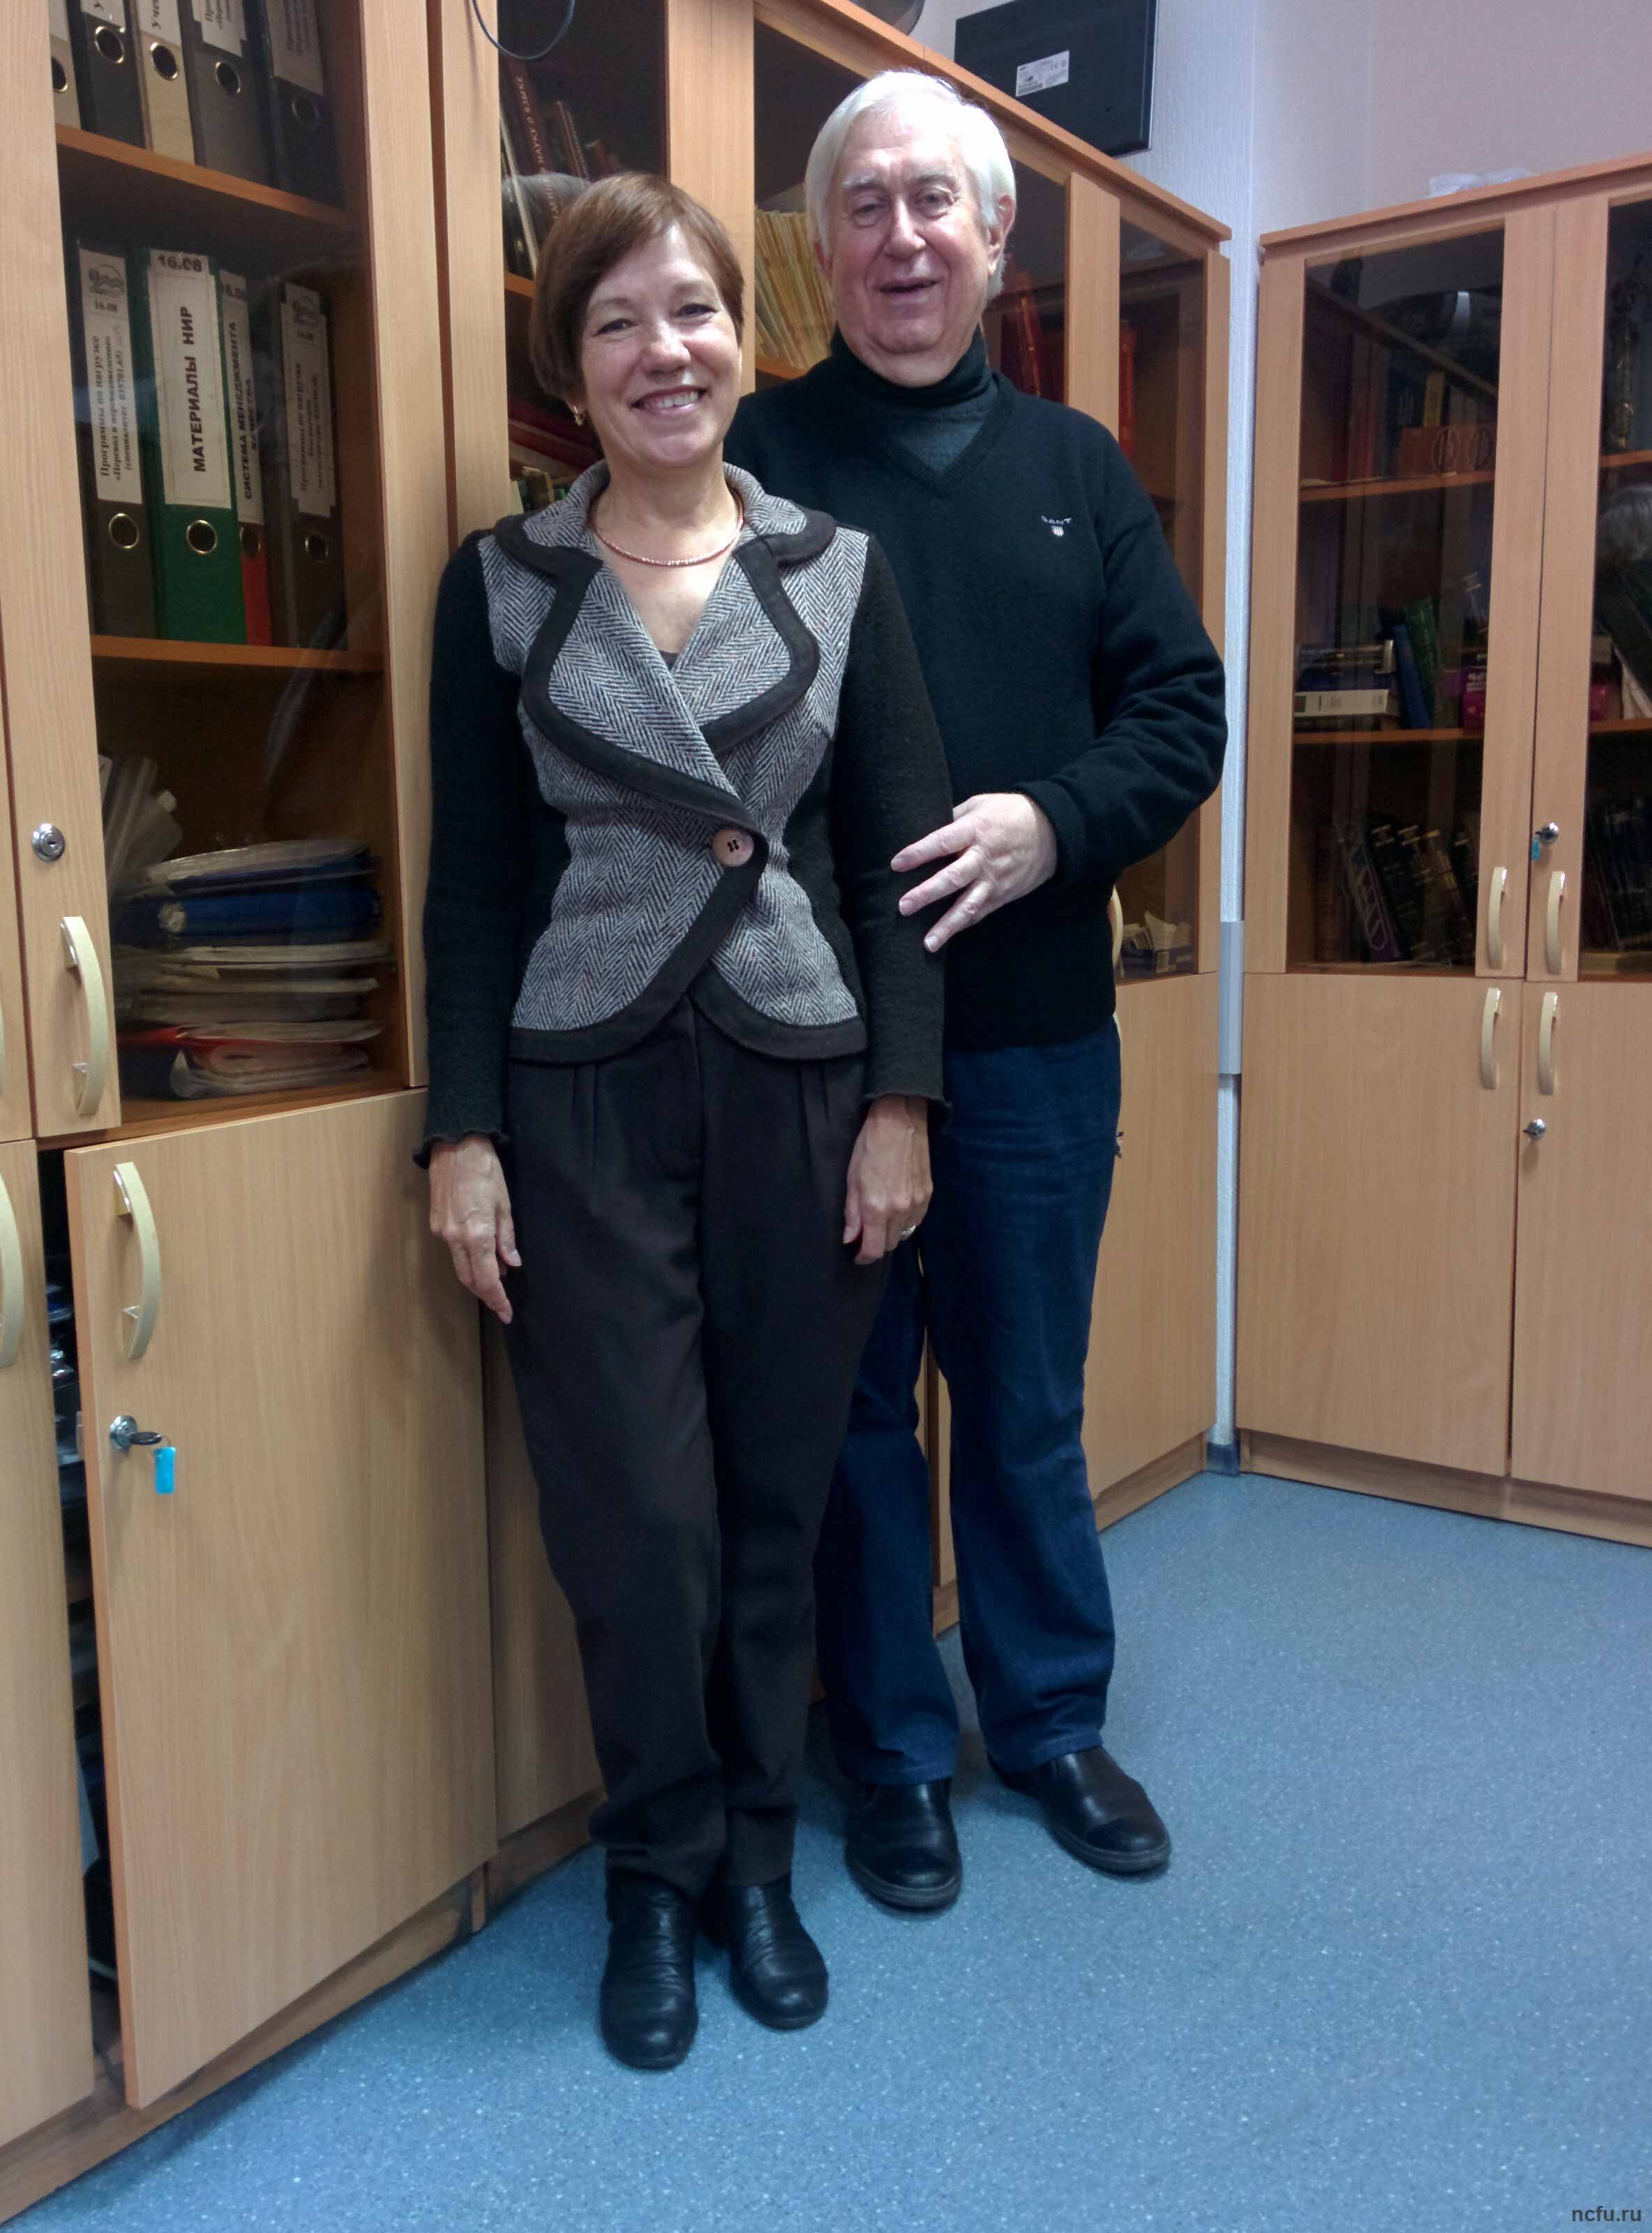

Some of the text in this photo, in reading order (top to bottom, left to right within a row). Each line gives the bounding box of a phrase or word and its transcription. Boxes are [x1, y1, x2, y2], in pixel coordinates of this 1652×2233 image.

[158, 254, 202, 272] 16.08
[91, 335, 104, 389] нагрузке
[179, 306, 206, 473] МАТЕРИАЛЫ НИР
[96, 408, 110, 477] Программы
[227, 321, 253, 500] СИСТЕМА МЕНЕДЖМЕНТА
